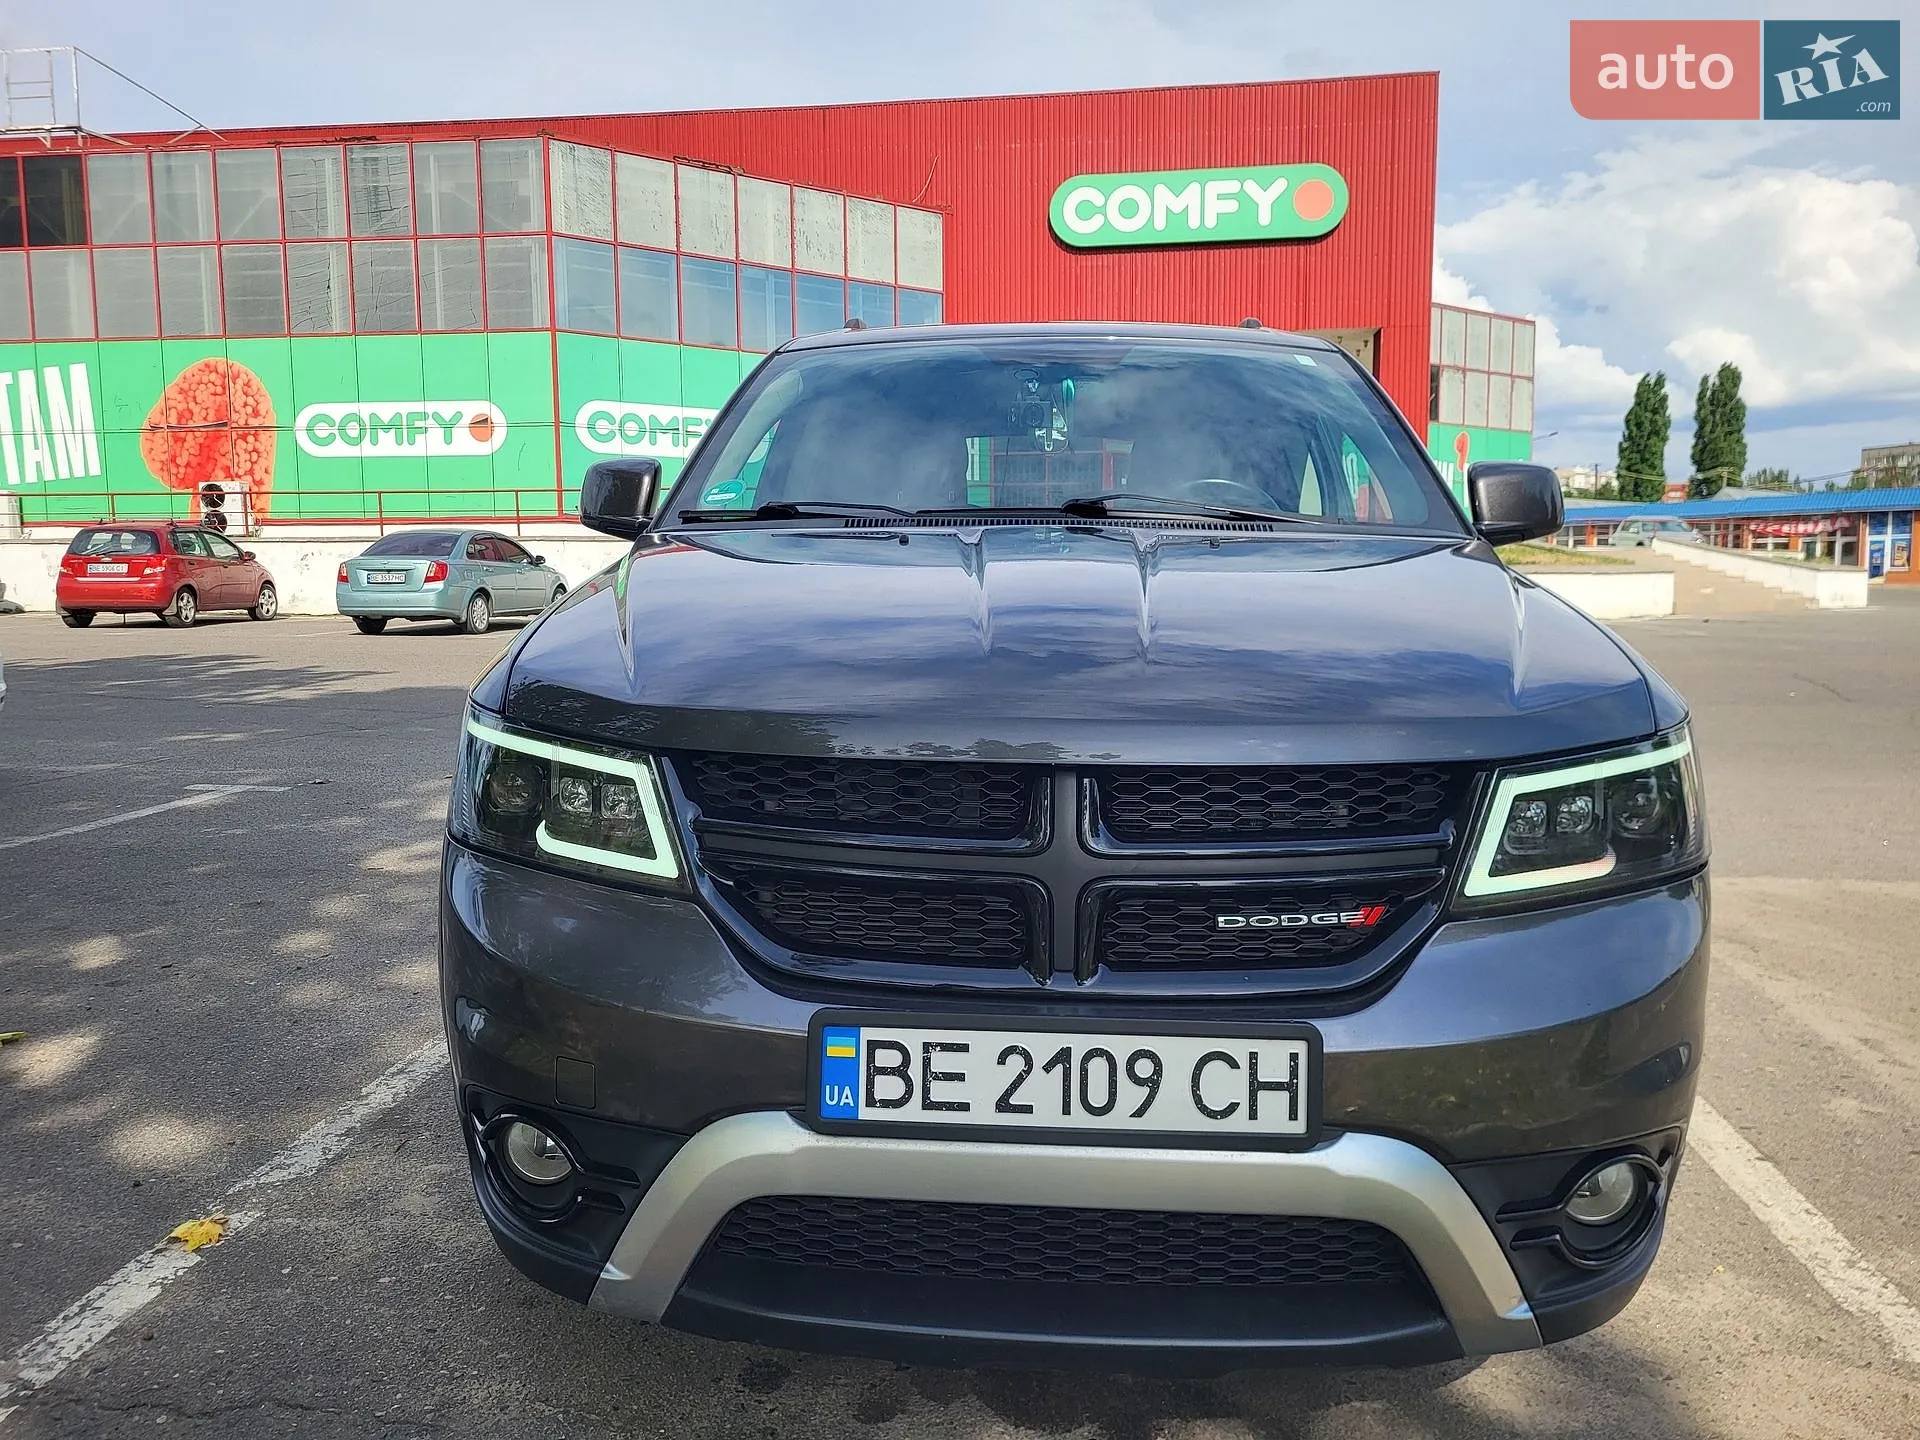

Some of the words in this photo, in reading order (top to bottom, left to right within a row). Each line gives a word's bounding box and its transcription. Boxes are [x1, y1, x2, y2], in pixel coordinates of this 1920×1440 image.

[1062, 176, 1289, 235] COMFY
[306, 411, 464, 447] COMFY
[587, 410, 714, 448] COMF
[1217, 911, 1366, 928] DODGE
[825, 1085, 855, 1108] UA
[864, 1039, 971, 1113] BE
[995, 1043, 1164, 1119] 2109
[1190, 1050, 1300, 1121] CH
